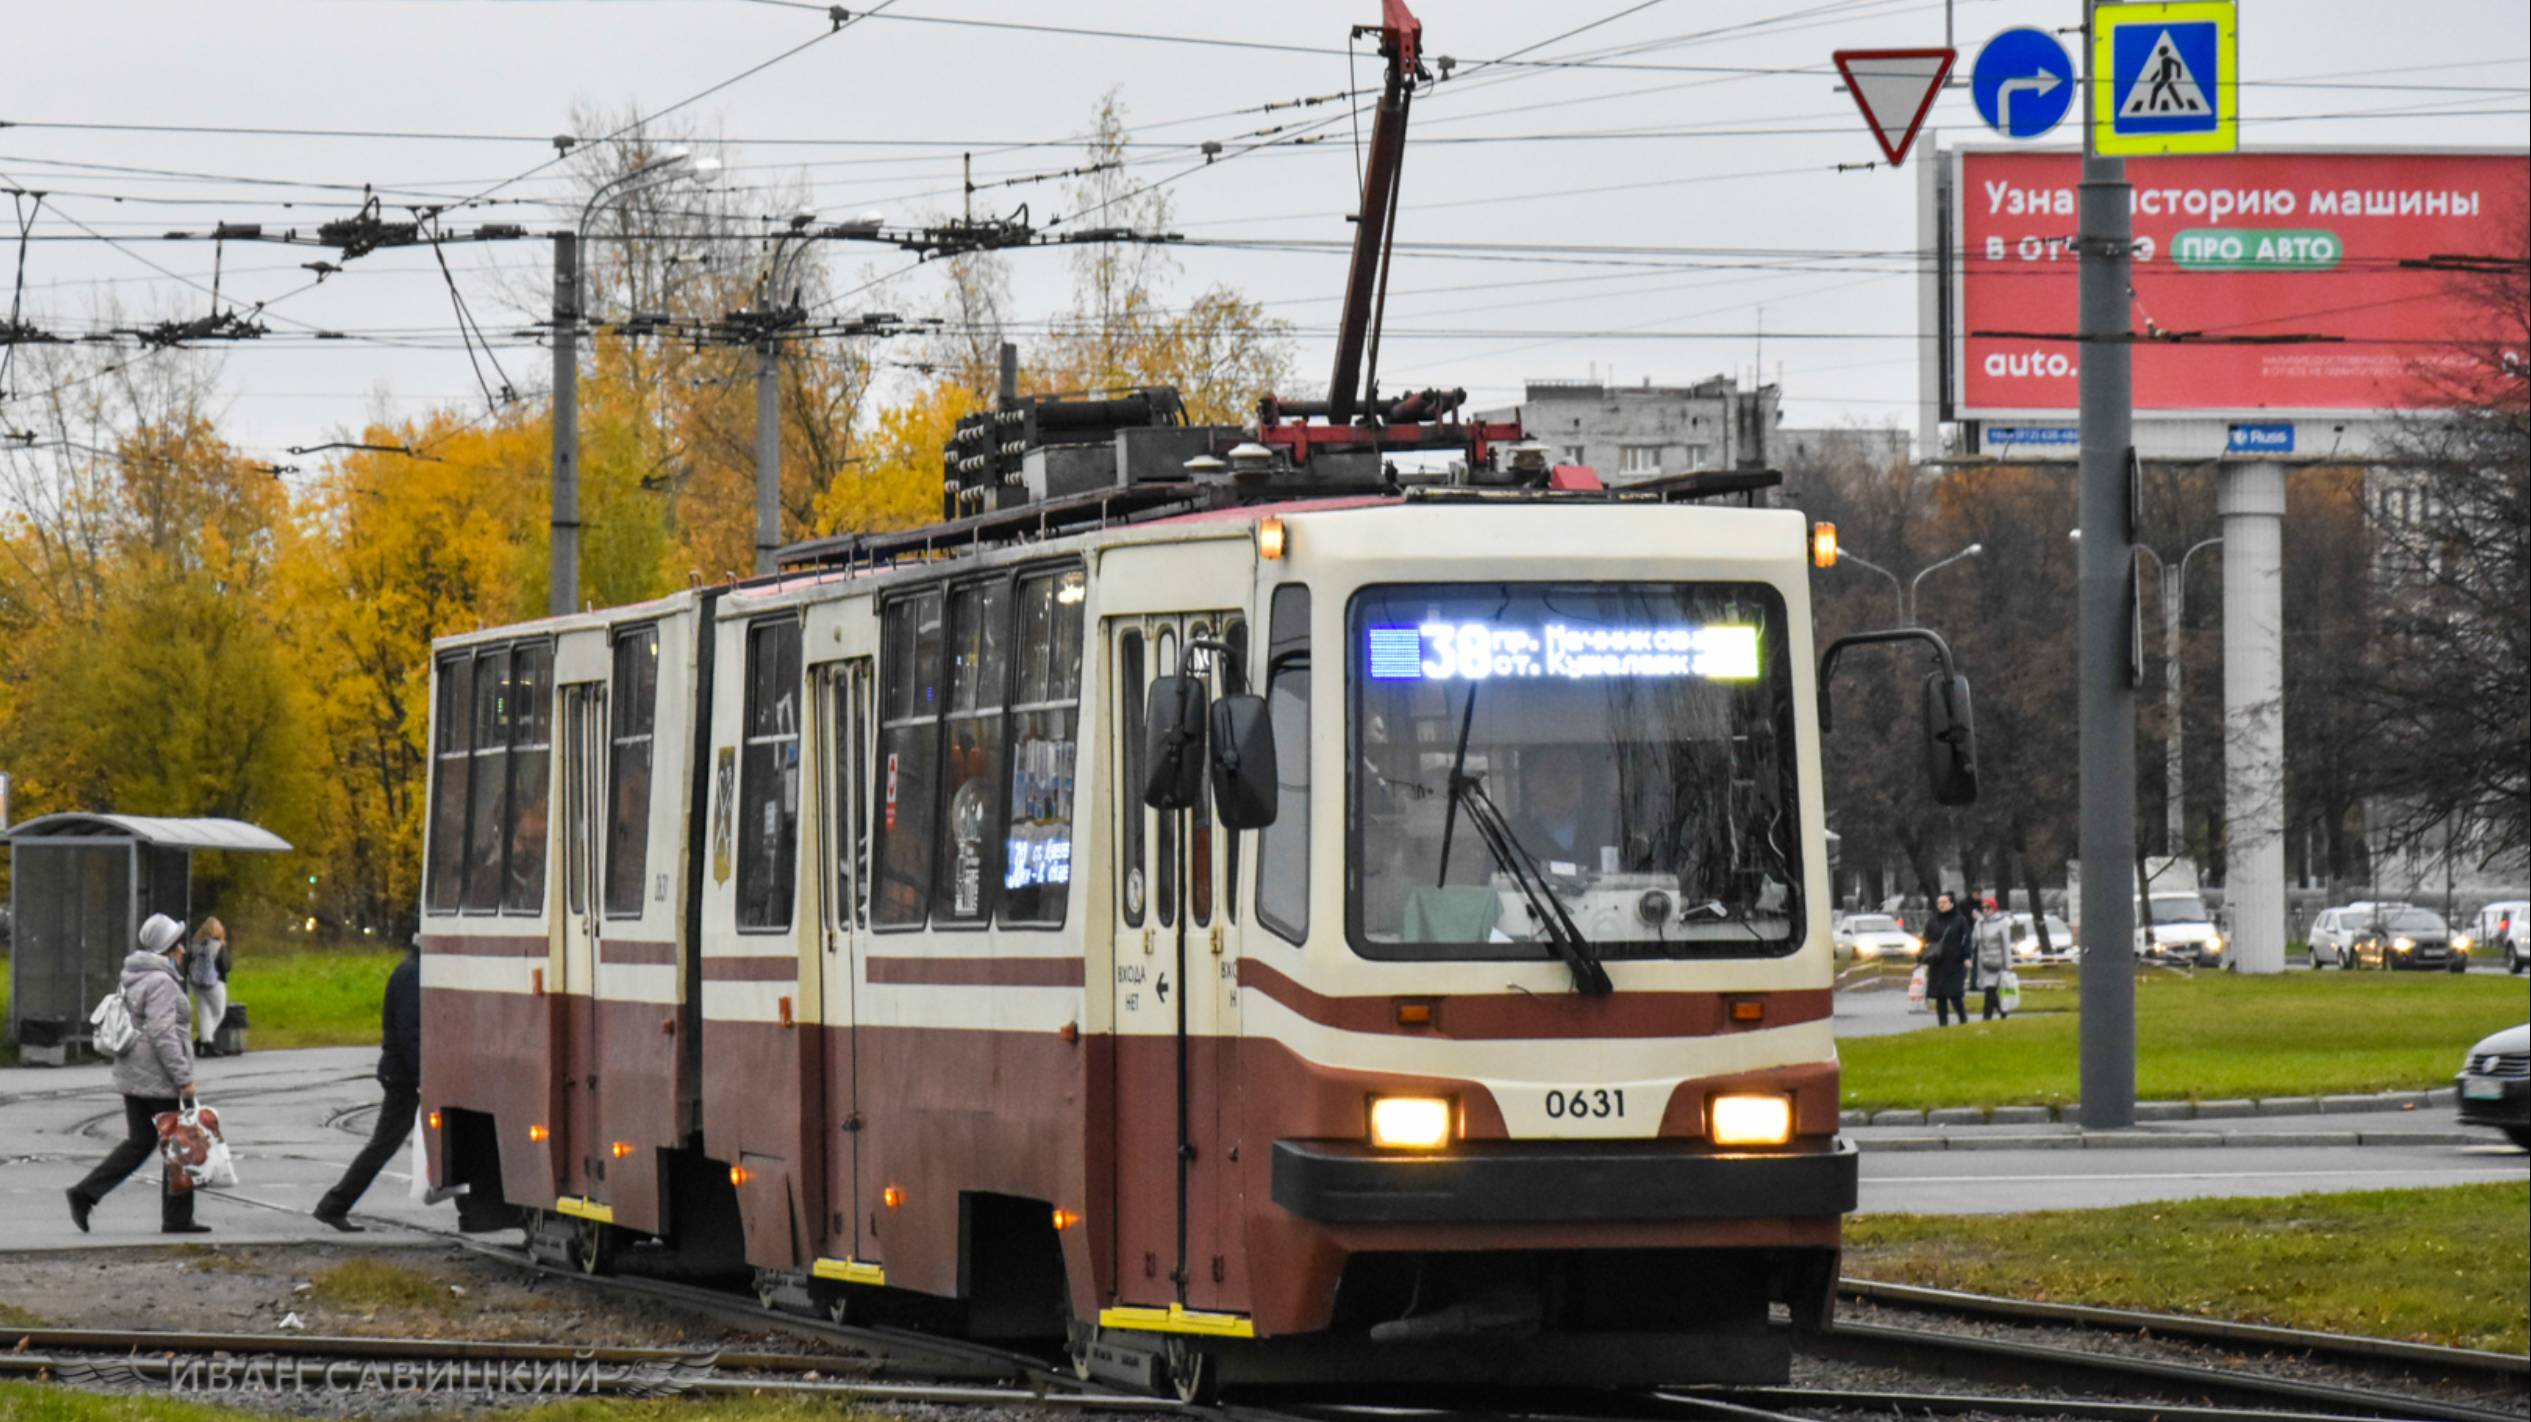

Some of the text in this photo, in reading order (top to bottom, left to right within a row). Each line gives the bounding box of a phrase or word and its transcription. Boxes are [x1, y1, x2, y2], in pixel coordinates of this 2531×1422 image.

[1985, 180, 2479, 224] Узна сторию машины
[2182, 237, 2243, 262] ПРО
[2255, 238, 2335, 262] АВТО
[1419, 624, 1492, 679] 38
[1118, 965, 1146, 984] ВХОДА
[1221, 961, 1238, 979] ВХО
[1126, 993, 1139, 1011] НЕТ
[1545, 1089, 1624, 1118] 0631
